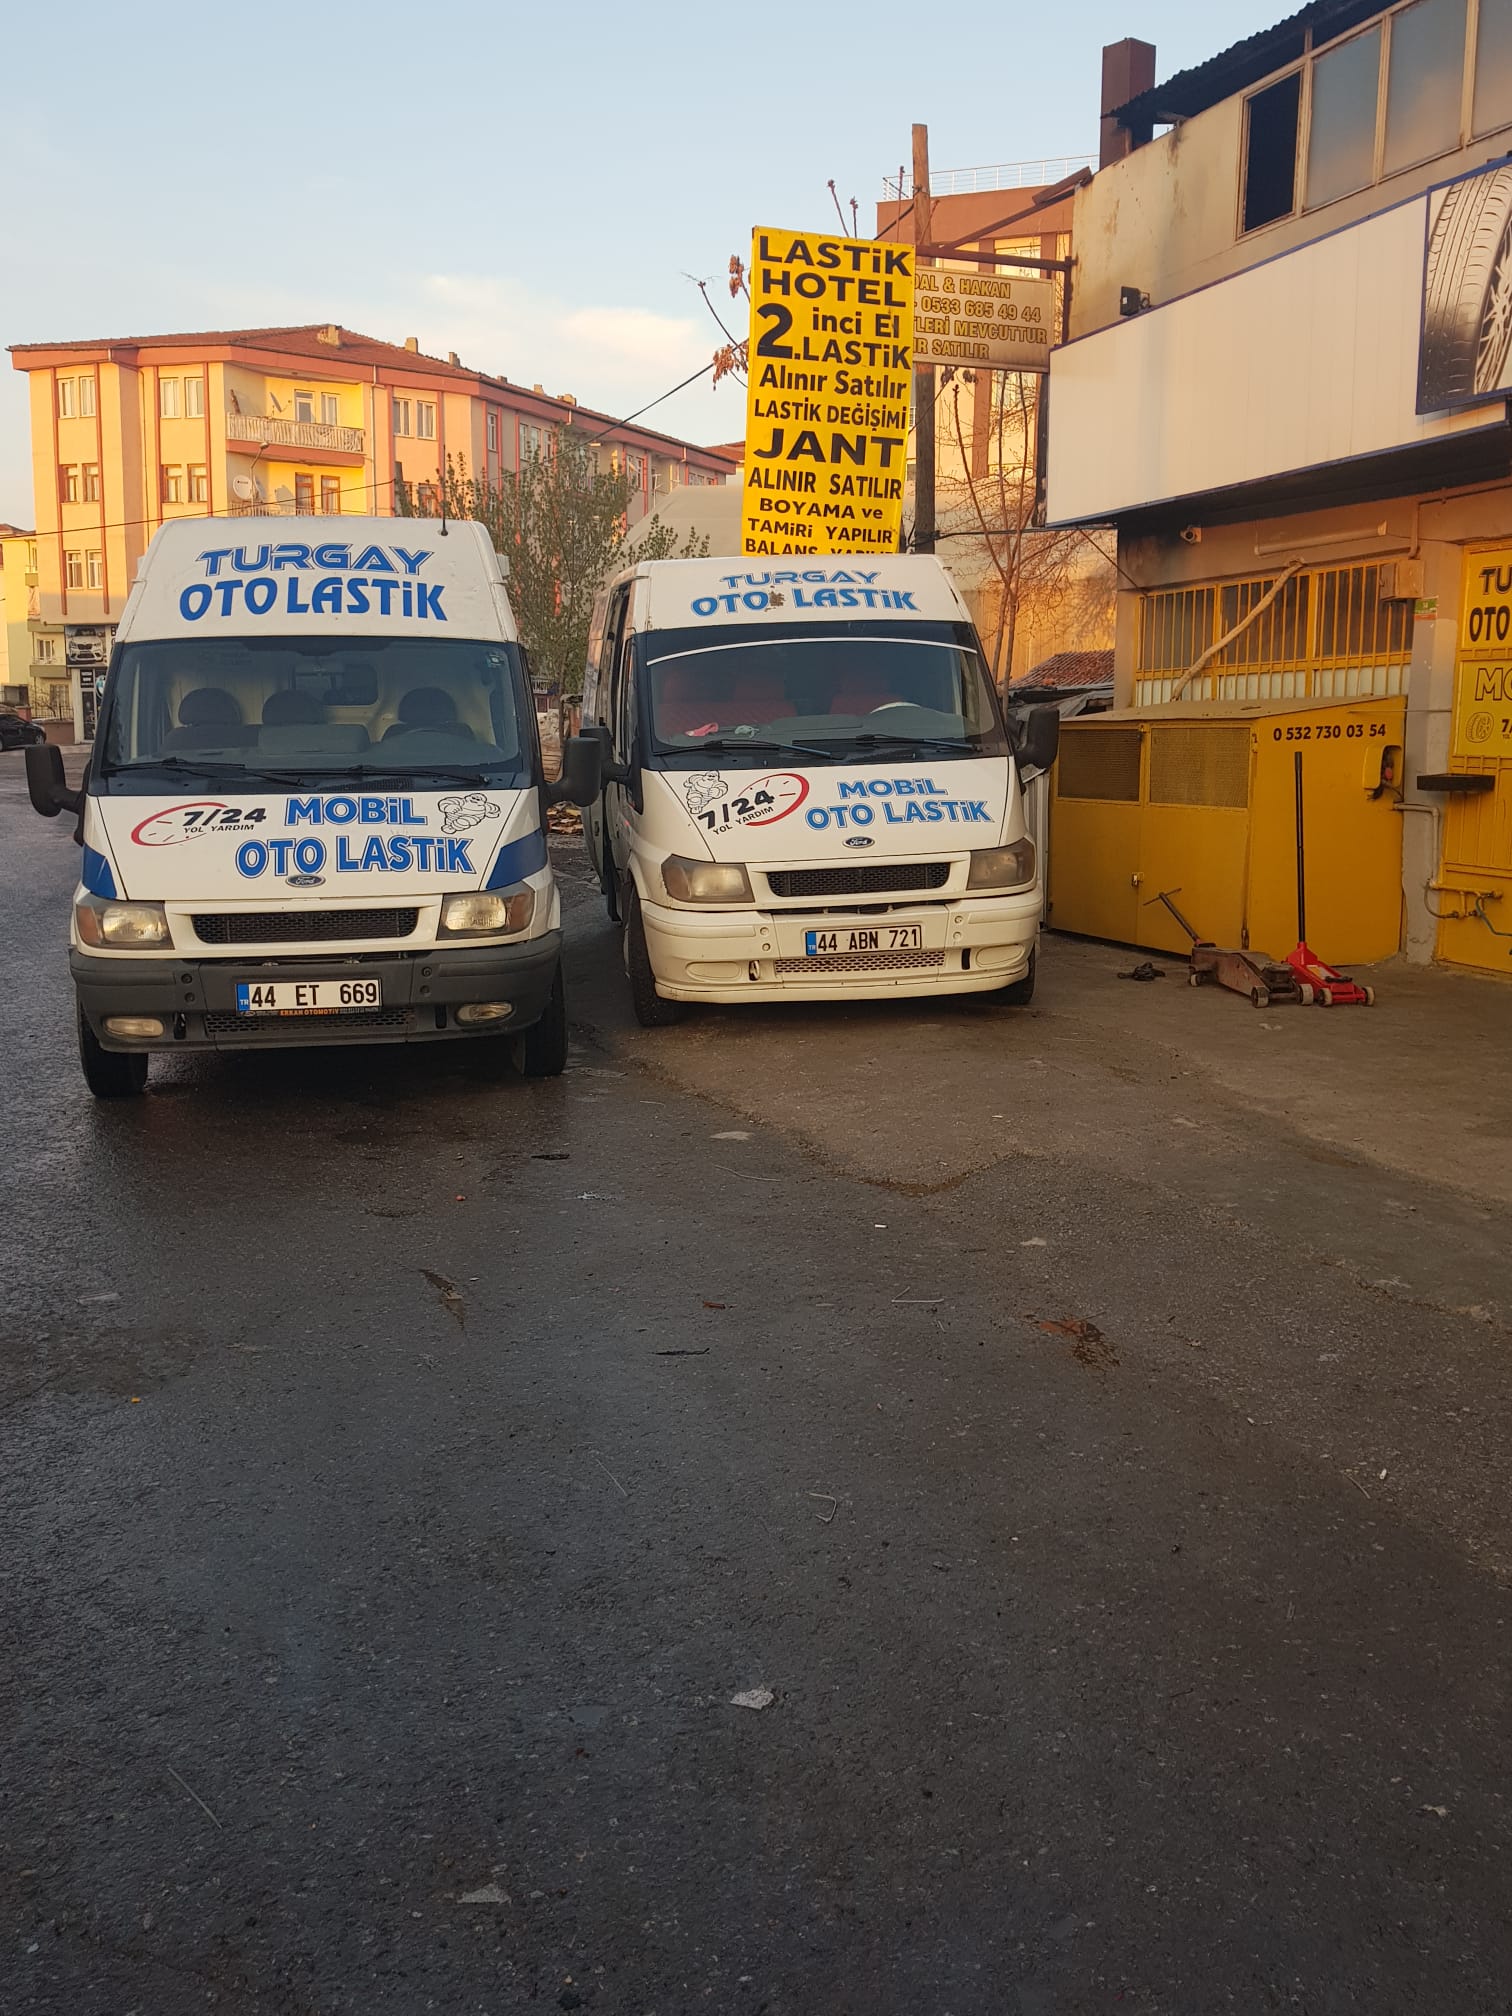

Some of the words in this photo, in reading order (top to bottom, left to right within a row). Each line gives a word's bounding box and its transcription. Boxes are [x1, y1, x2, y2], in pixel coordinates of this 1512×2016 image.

[759, 235, 912, 277] LASTiK
[762, 268, 906, 308] HOTEL
[943, 276, 955, 293] &
[960, 278, 1011, 299] HAKAN
[812, 306, 862, 335] inci
[875, 313, 900, 338] El
[921, 295, 960, 315] 0533
[965, 300, 994, 318] 685
[998, 303, 1017, 320] 49
[1021, 305, 1041, 323] 44
[954, 320, 1047, 344] MEVCUTTUR
[932, 338, 990, 359] SATILIR
[759, 363, 828, 393] Alınır
[834, 369, 907, 400] Satılır
[754, 397, 822, 422] LASTİK
[826, 402, 907, 432] DEĞİŞİMİ
[753, 427, 904, 468] JANT
[748, 466, 817, 494] ALINIR
[829, 473, 902, 500] SATILIR
[759, 497, 856, 520] BOYAMA
[861, 507, 883, 520] ve
[826, 525, 893, 544] YAPILIR
[195, 543, 435, 577] TURGAY
[719, 569, 881, 589] TURGAY
[179, 577, 278, 621] OTO
[286, 576, 448, 622] LASTiK
[690, 590, 770, 617] OTO
[791, 587, 922, 613] LASTiK
[1468, 605, 1511, 642] OTO
[1273, 728, 1282, 740] 0
[1286, 726, 1311, 740] 532
[1316, 725, 1341, 739] 730
[1346, 724, 1363, 738] 03
[1369, 723, 1386, 737] 54
[837, 778, 948, 799] MOBiL
[182, 807, 267, 827] 7/24
[284, 797, 428, 826] MOBiL
[698, 789, 775, 831] 7/24
[712, 823, 734, 836] YOL
[735, 805, 774, 825] YARDIM
[804, 802, 875, 831] OTO
[882, 799, 995, 825] LASTiK
[183, 826, 204, 834] YOL
[210, 823, 255, 833] YARDIM
[235, 838, 327, 879] OTO
[336, 834, 477, 875] LASTiK
[818, 933, 838, 951] 44
[848, 931, 879, 950] ABN
[888, 928, 918, 948] 721
[251, 985, 277, 1008] 44
[295, 984, 320, 1006] ET
[340, 982, 377, 1005] 669
